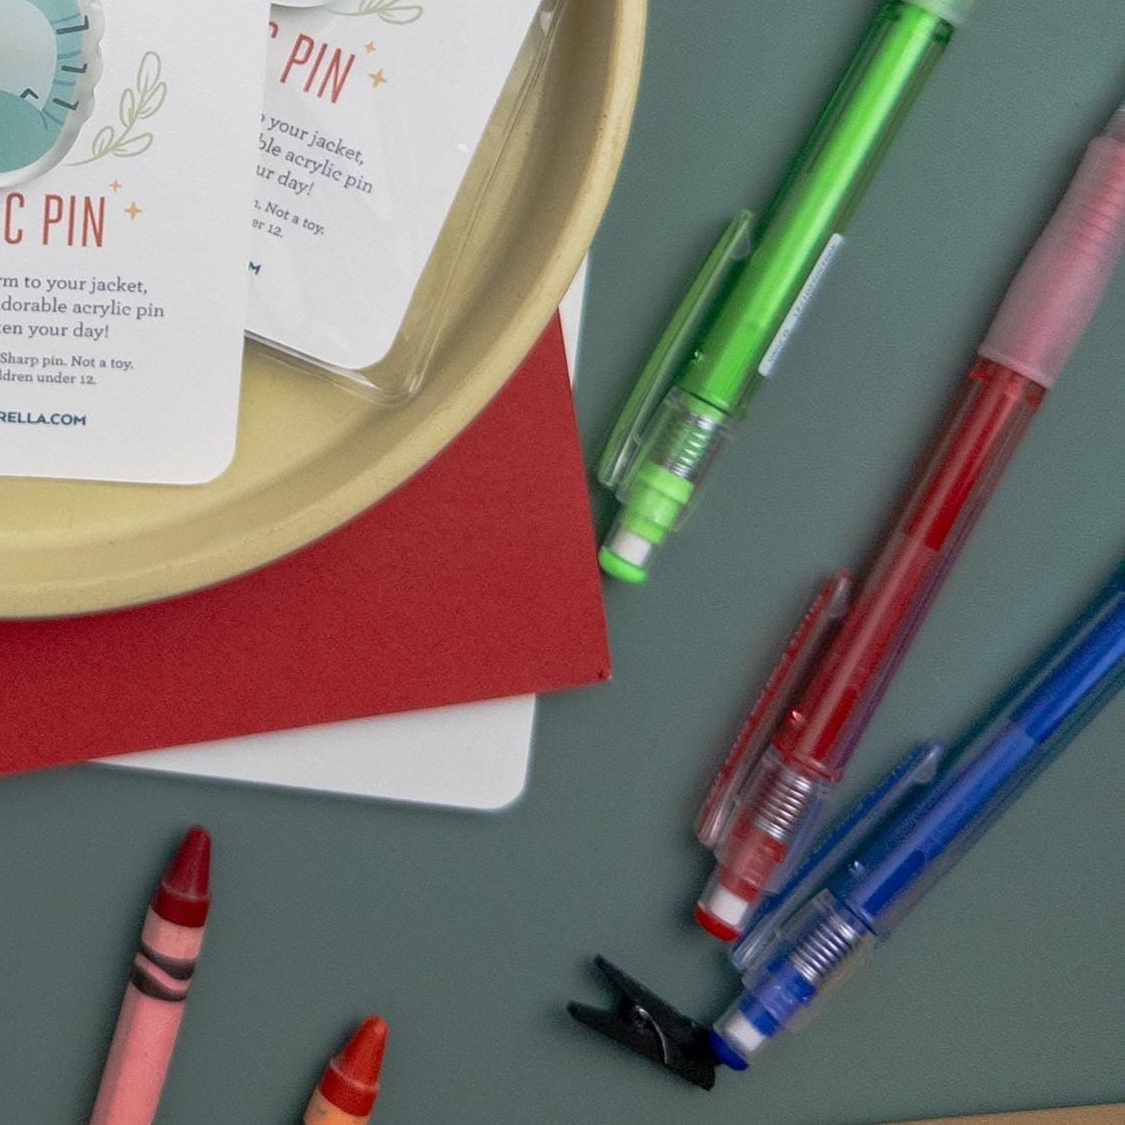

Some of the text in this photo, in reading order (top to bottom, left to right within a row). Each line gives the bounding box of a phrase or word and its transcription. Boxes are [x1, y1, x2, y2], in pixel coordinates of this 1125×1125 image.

[279, 33, 356, 104] PIN
[267, 115, 309, 142] your
[307, 130, 365, 166] jacket,
[284, 149, 374, 195] acrylic pin
[276, 172, 315, 197] day!
[41, 193, 107, 248] PIN
[264, 201, 291, 221] Not
[291, 215, 300, 225] a
[301, 217, 325, 236] toy.
[267, 224, 284, 239] 12.
[24, 276, 42, 289] to
[46, 277, 87, 293] your
[89, 276, 148, 295] jacket,
[72, 299, 132, 318] acrylic
[136, 303, 165, 320] pin
[28, 324, 69, 339] your
[72, 321, 109, 341] day!
[0, 352, 39, 367] Sharp
[42, 354, 68, 368] pin.
[70, 355, 96, 369] Not
[99, 359, 107, 368] a
[110, 358, 134, 371] toy.
[37, 371, 77, 384] under
[80, 375, 97, 385] 12.
